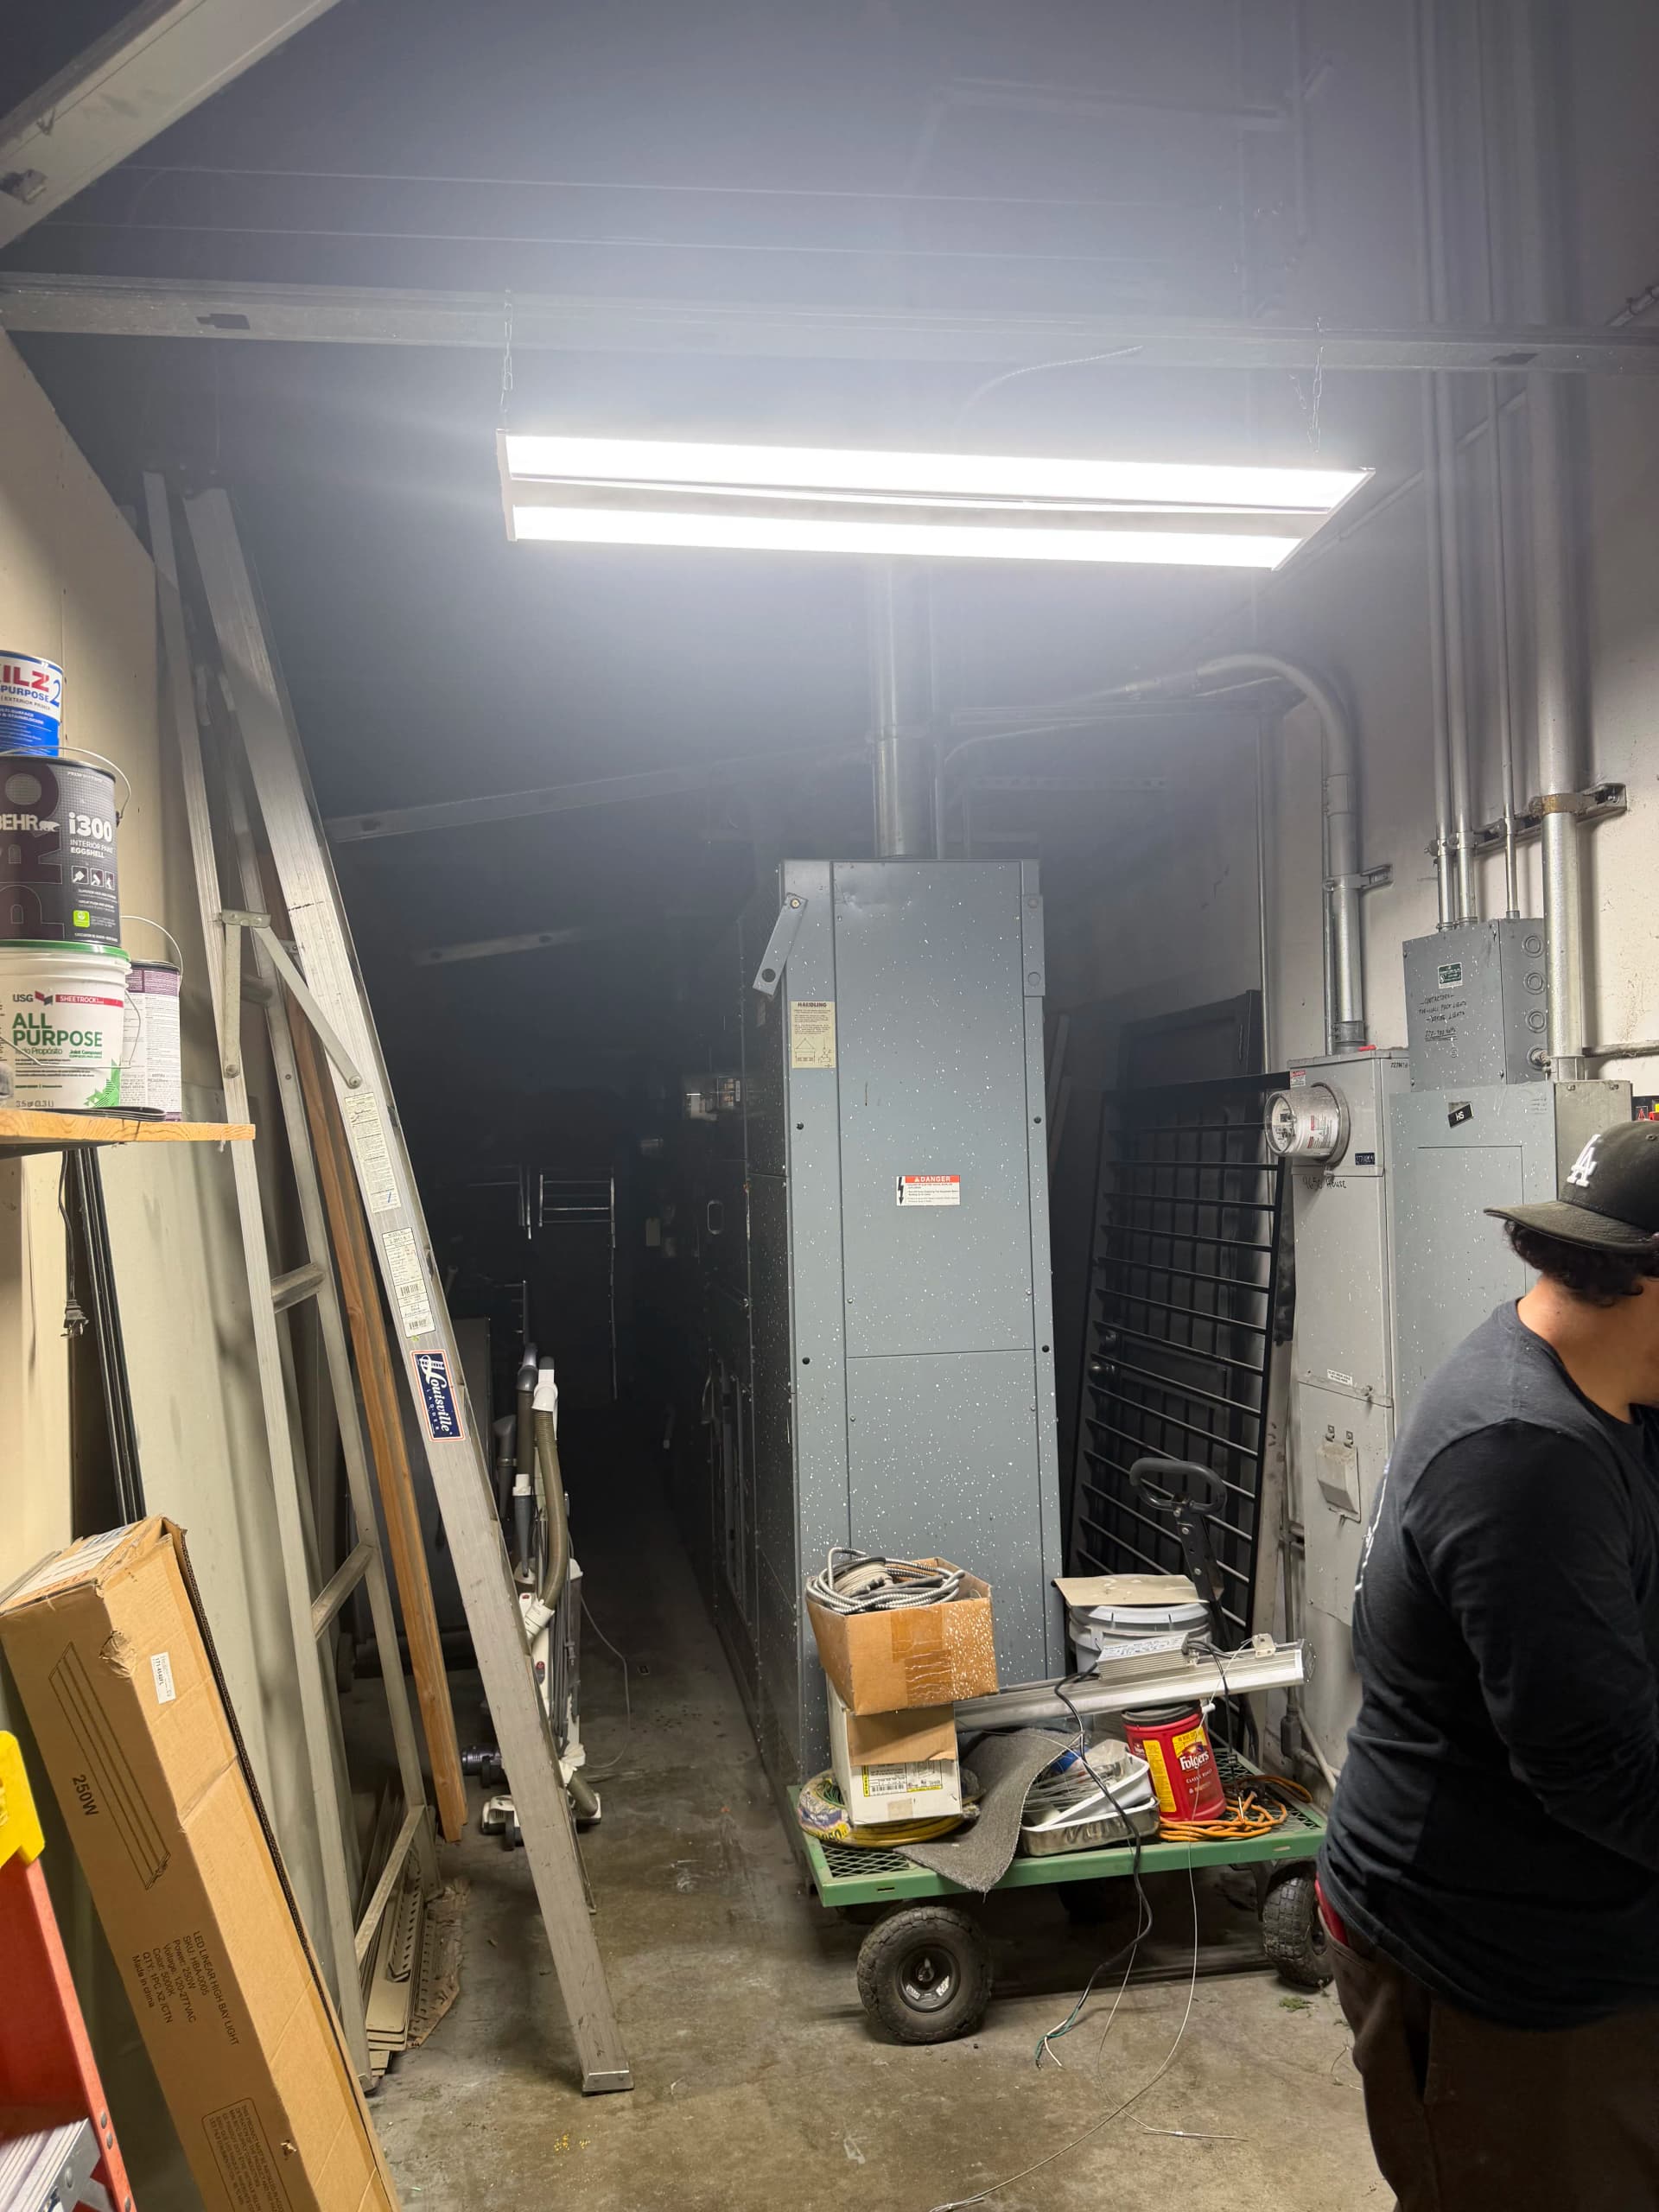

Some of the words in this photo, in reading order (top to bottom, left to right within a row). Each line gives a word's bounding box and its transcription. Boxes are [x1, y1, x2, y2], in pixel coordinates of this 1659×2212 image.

[0, 664, 49, 692] ILZ
[0, 685, 49, 703] PURPOSE
[69, 812, 112, 842] i300
[71, 848, 105, 858] EGGSHELL
[12, 1013, 53, 1028] ALL
[13, 1030, 103, 1046] PURPOSE
[419, 1355, 453, 1432] Louisville
[1179, 1751, 1209, 1770] Folgers
[72, 1774, 99, 1815] 250W
[182, 1935, 195, 1955] SKU:
[193, 1930, 205, 1949] LED
[131, 1955, 145, 1977] Made
[140, 1978, 149, 1986] in
[141, 1952, 155, 1972] QTY:
[152, 1948, 166, 1971] Color:
[161, 1971, 175, 1997] 5000K
[173, 1940, 188, 1966] Power:
[181, 1967, 196, 1990] 250W
[199, 1949, 216, 1980] LINEAR
[210, 1980, 224, 2003] HIGH
[218, 2002, 231, 2021] BAY
[224, 2020, 239, 2047] LIGHT
